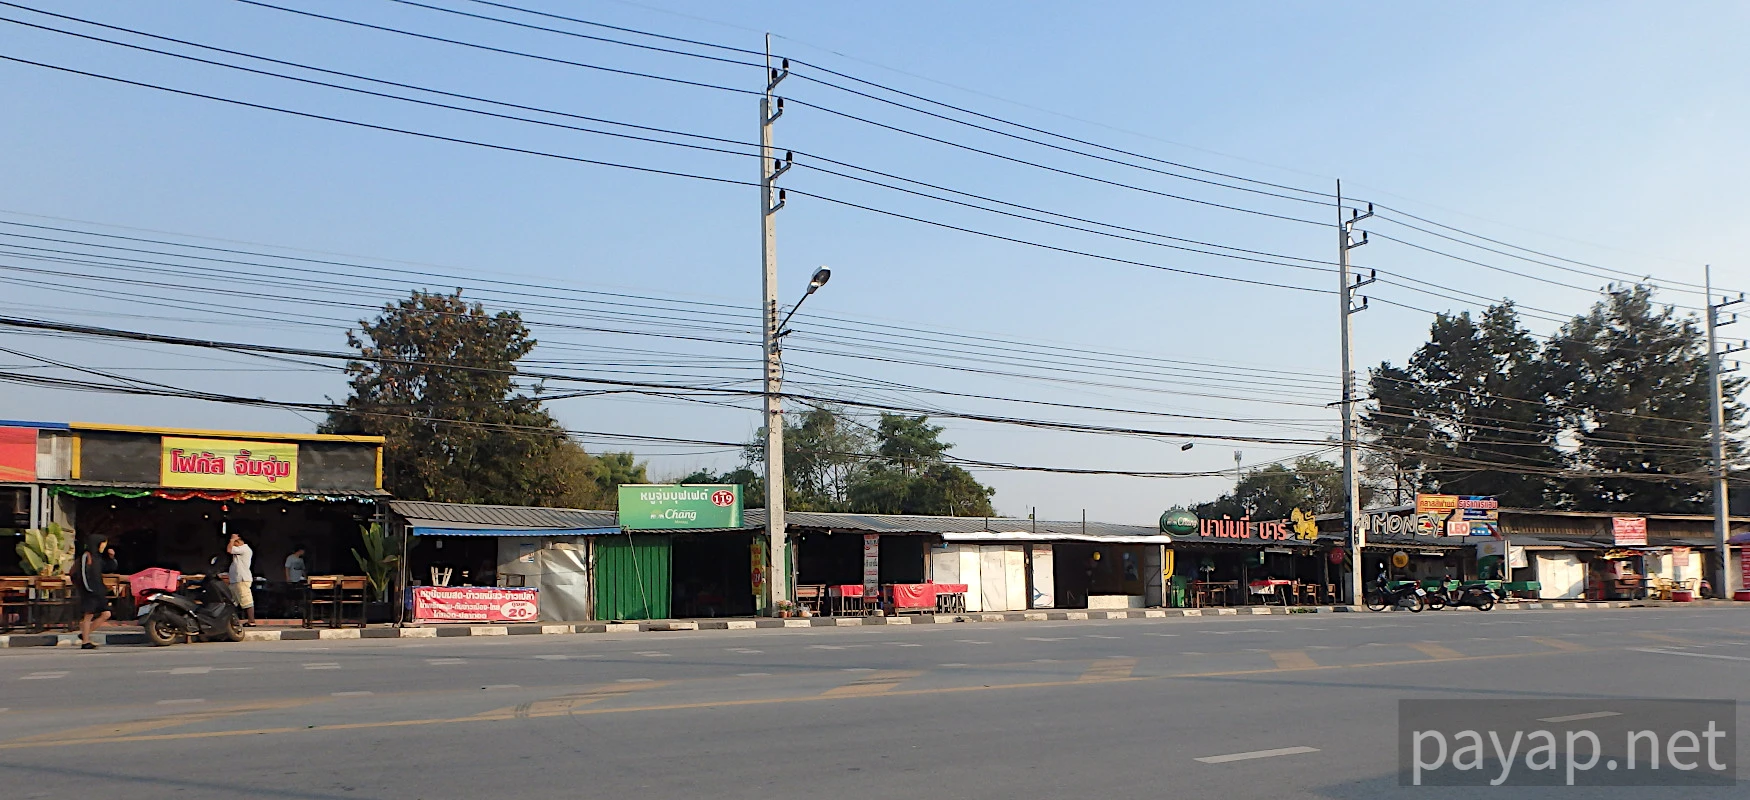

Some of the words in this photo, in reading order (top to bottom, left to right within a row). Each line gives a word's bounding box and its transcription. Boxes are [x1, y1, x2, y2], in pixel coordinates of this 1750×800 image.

[170, 448, 225, 474] โฟกัส
[234, 449, 290, 483] จิ้มจุ่ม
[640, 489, 709, 504] หมูจุ่มบุฟเฟต์
[713, 494, 733, 503] 119
[665, 509, 697, 521] Chang
[1200, 510, 1250, 539] มามันนี่
[1259, 518, 1290, 541] บาร์
[1372, 512, 1441, 538] MONEY
[1449, 523, 1468, 534] LEO
